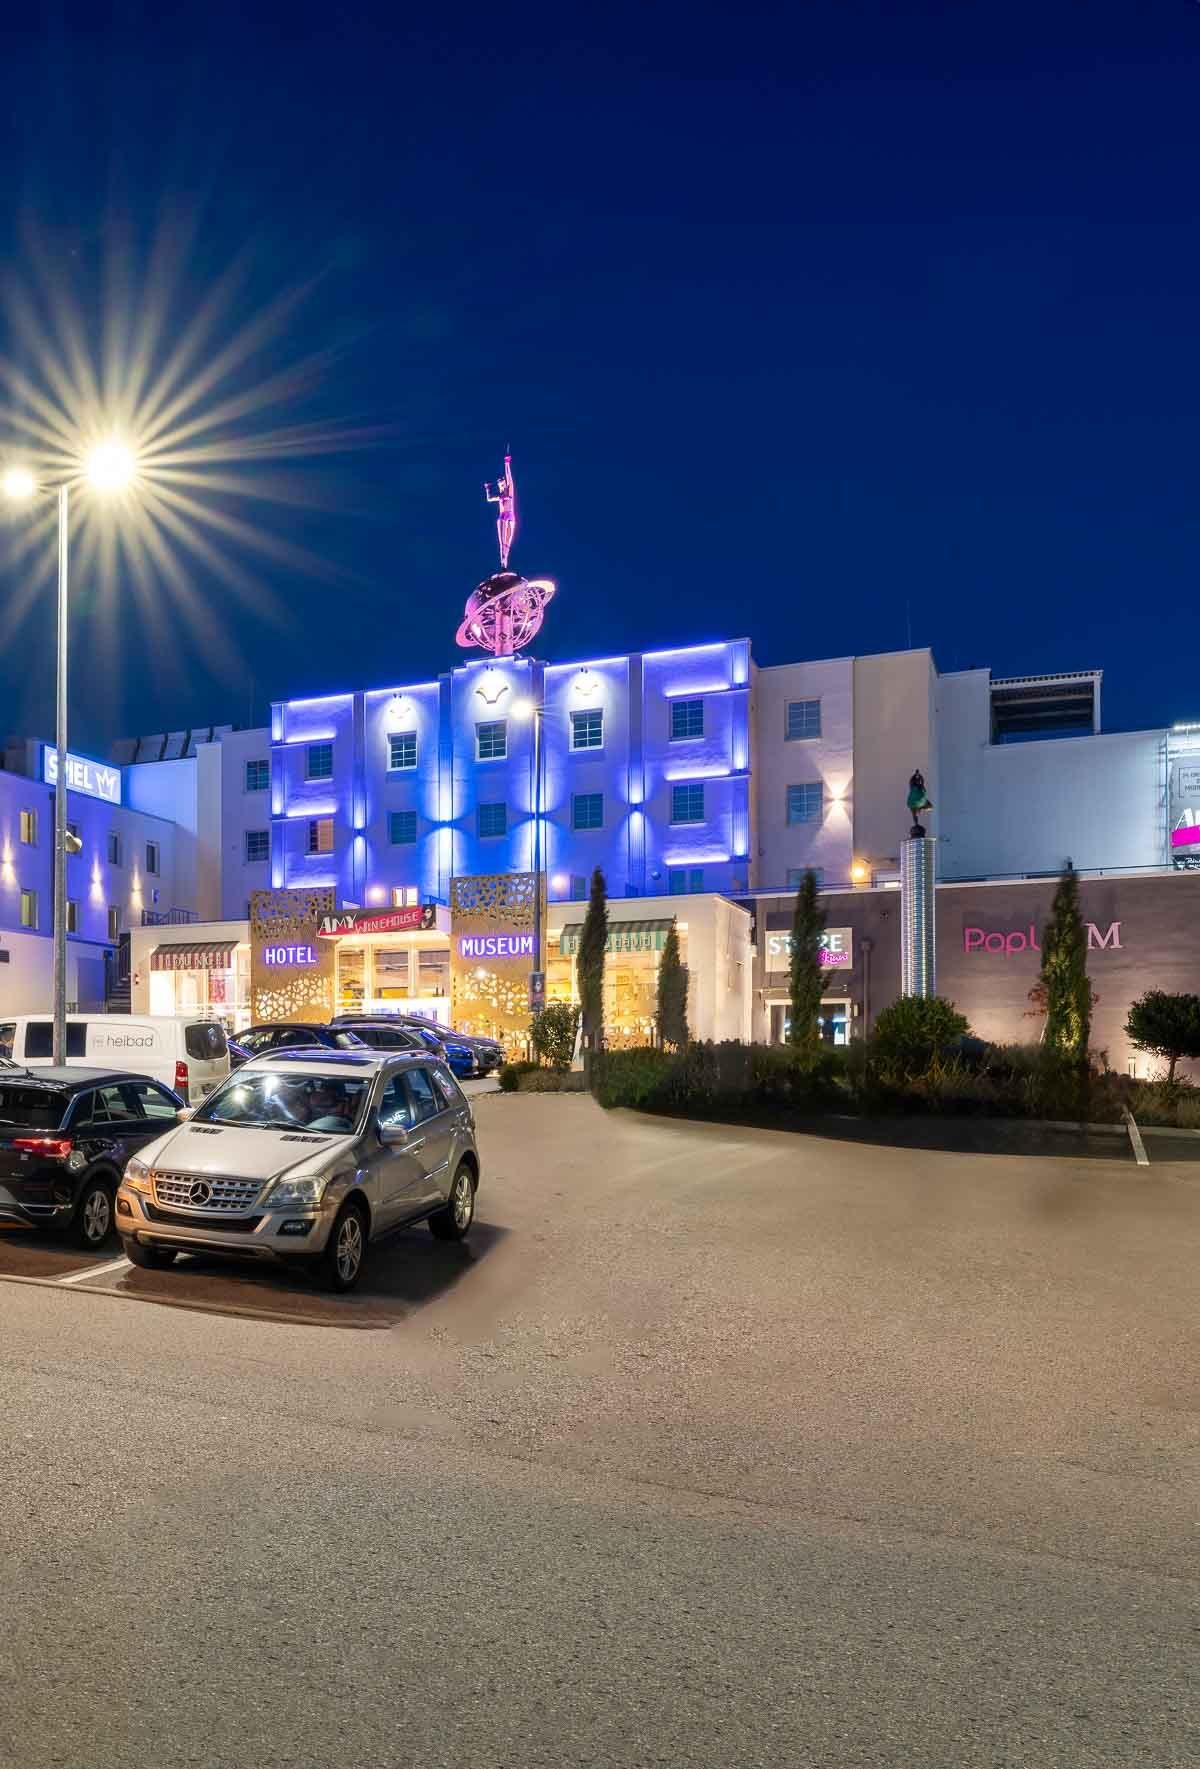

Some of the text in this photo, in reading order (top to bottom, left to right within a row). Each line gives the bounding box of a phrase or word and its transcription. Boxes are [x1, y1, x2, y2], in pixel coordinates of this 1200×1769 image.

[48, 754, 93, 790] SIEL
[320, 911, 419, 934] AMY WINEHOUSE
[265, 946, 317, 964] HOTEL
[461, 935, 534, 956] MUSEUM
[768, 933, 843, 955] STRE
